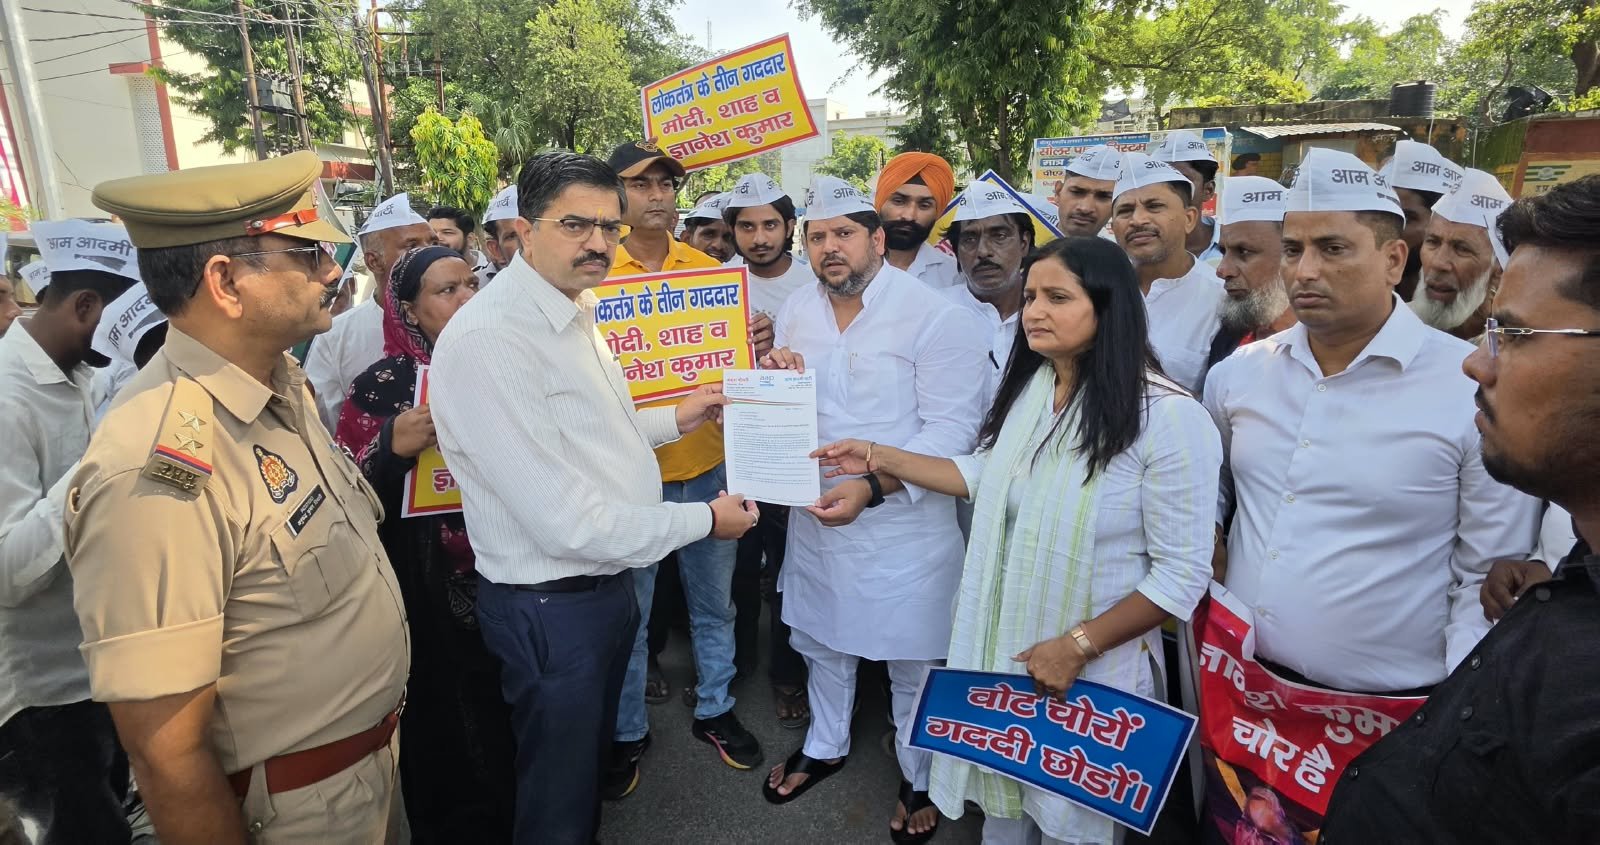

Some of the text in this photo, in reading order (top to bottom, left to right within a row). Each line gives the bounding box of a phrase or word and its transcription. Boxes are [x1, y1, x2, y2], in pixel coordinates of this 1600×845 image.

[652, 80, 695, 115] लोकतंत्र
[696, 72, 710, 97] के
[712, 66, 739, 91] तीन
[662, 88, 780, 134] मोदी, शाह व
[667, 112, 794, 159] ज्ञानेश कुमार
[1332, 168, 1369, 186] आम
[1411, 160, 1441, 176] आम
[1242, 190, 1283, 203] आम
[1470, 194, 1504, 209] आम
[76, 236, 133, 257] आदमी
[638, 286, 653, 315] के
[656, 282, 685, 313] तीन
[659, 324, 703, 346] शाह
[710, 321, 727, 338] व
[670, 350, 735, 381] कुमार
[968, 682, 1145, 750] वोट चोरों
[1232, 716, 1335, 793] चोर है
